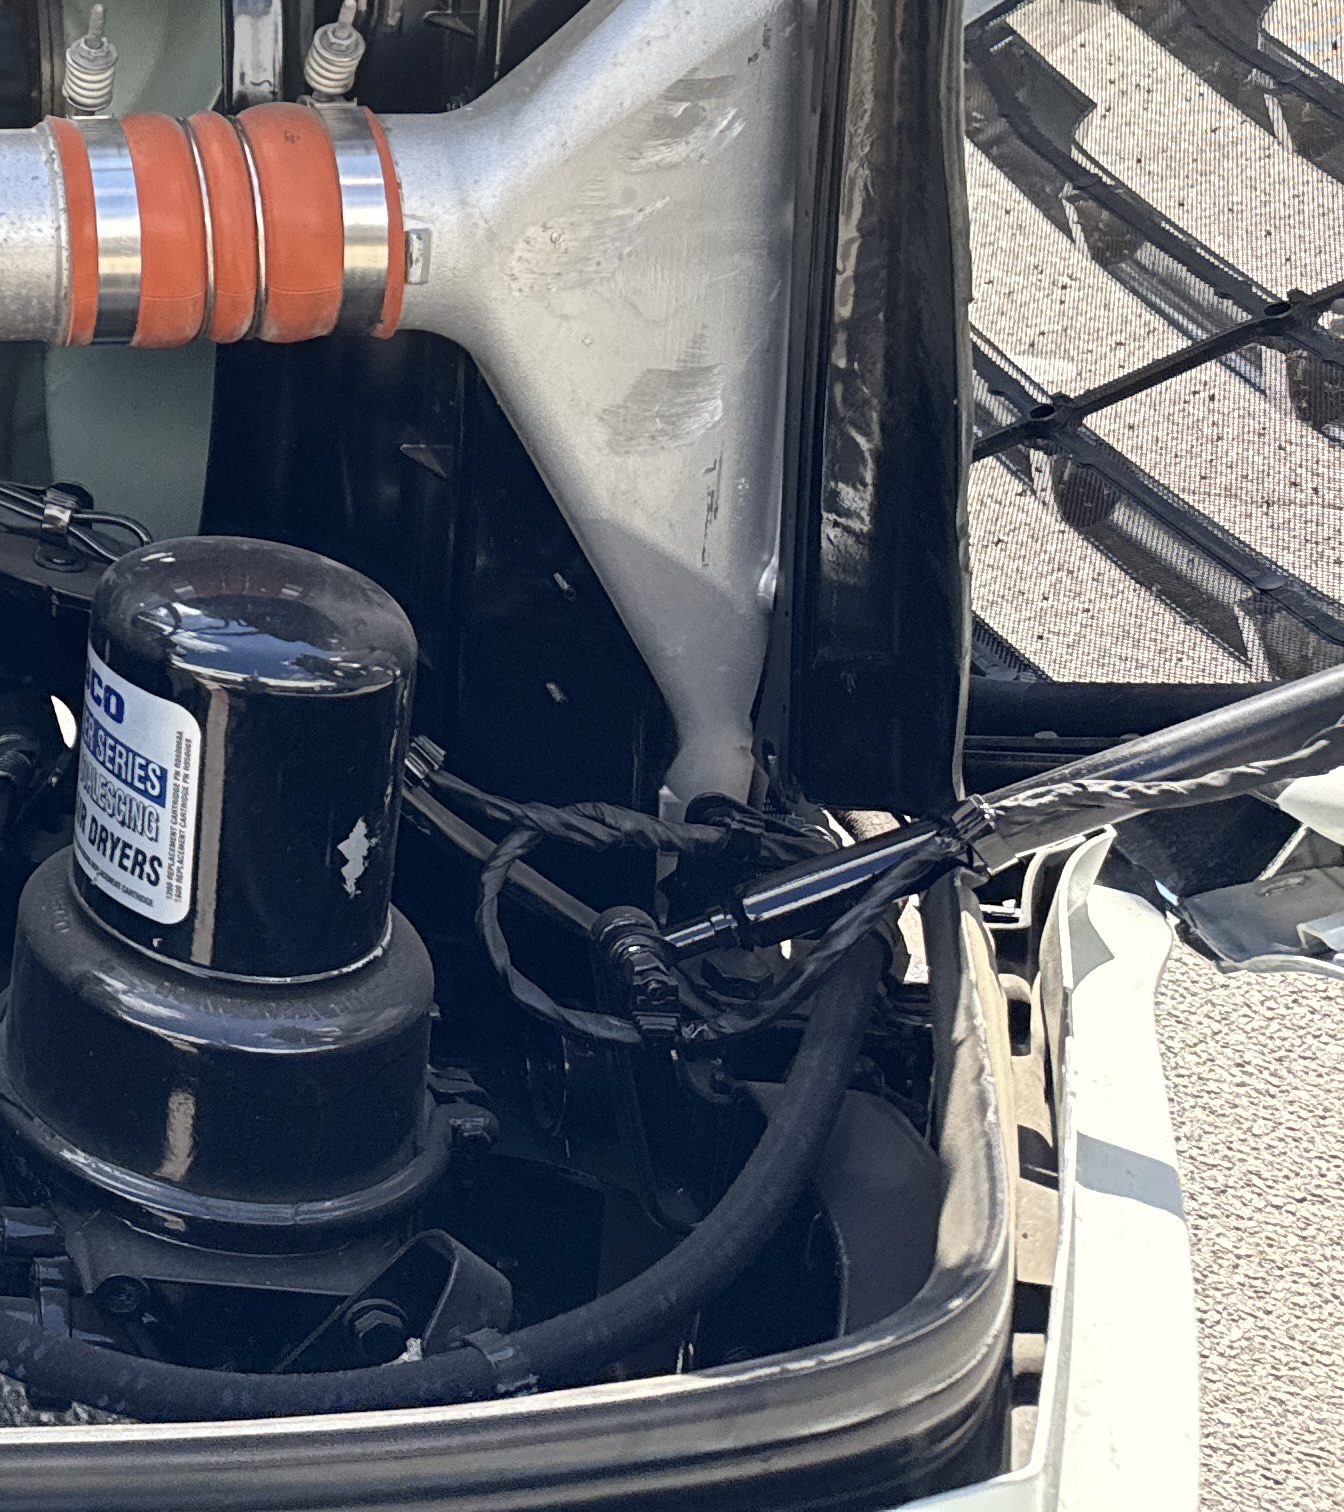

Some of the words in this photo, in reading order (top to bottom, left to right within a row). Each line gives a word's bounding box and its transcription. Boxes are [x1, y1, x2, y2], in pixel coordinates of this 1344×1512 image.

[95, 728, 161, 797] SERIES
[88, 813, 164, 887] DRYERS
[167, 825, 178, 881] REPLACEMENT
[175, 828, 187, 884] REPLACEMENT
